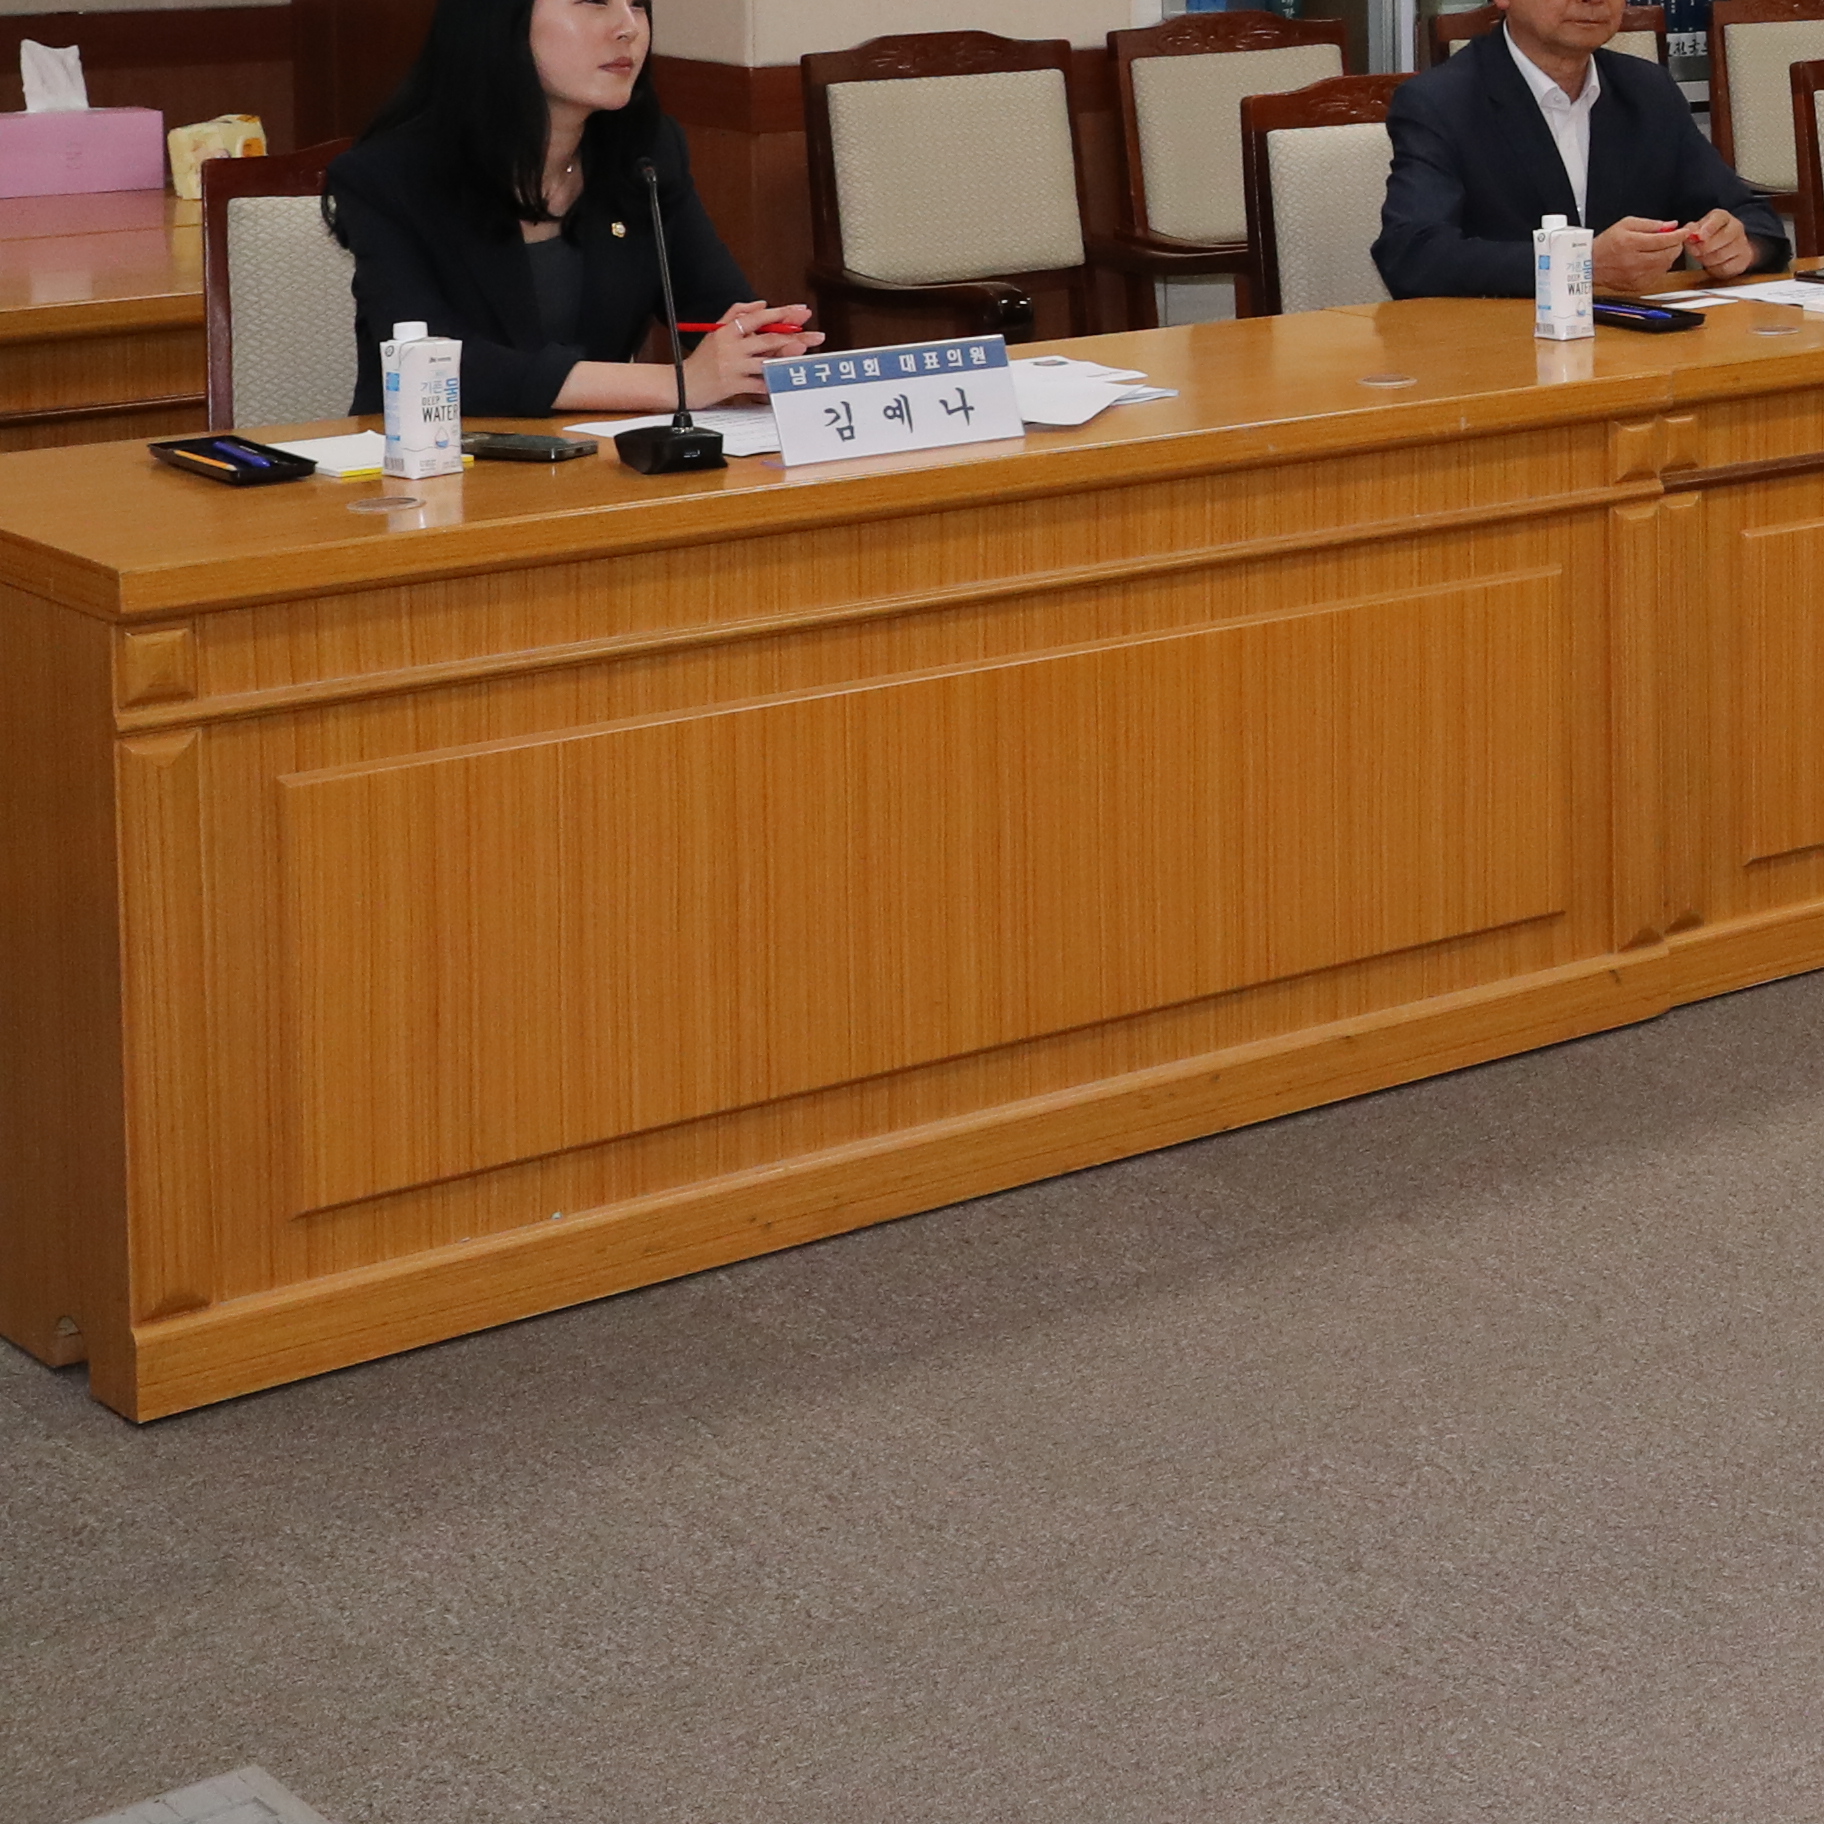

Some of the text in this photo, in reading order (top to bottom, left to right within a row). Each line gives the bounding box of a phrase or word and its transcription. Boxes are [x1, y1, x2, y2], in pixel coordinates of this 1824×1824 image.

[789, 345, 988, 386] 남구의회 대표의원
[421, 395, 441, 406] DEEP
[422, 403, 459, 423] WATER
[823, 387, 976, 442] 김예나
